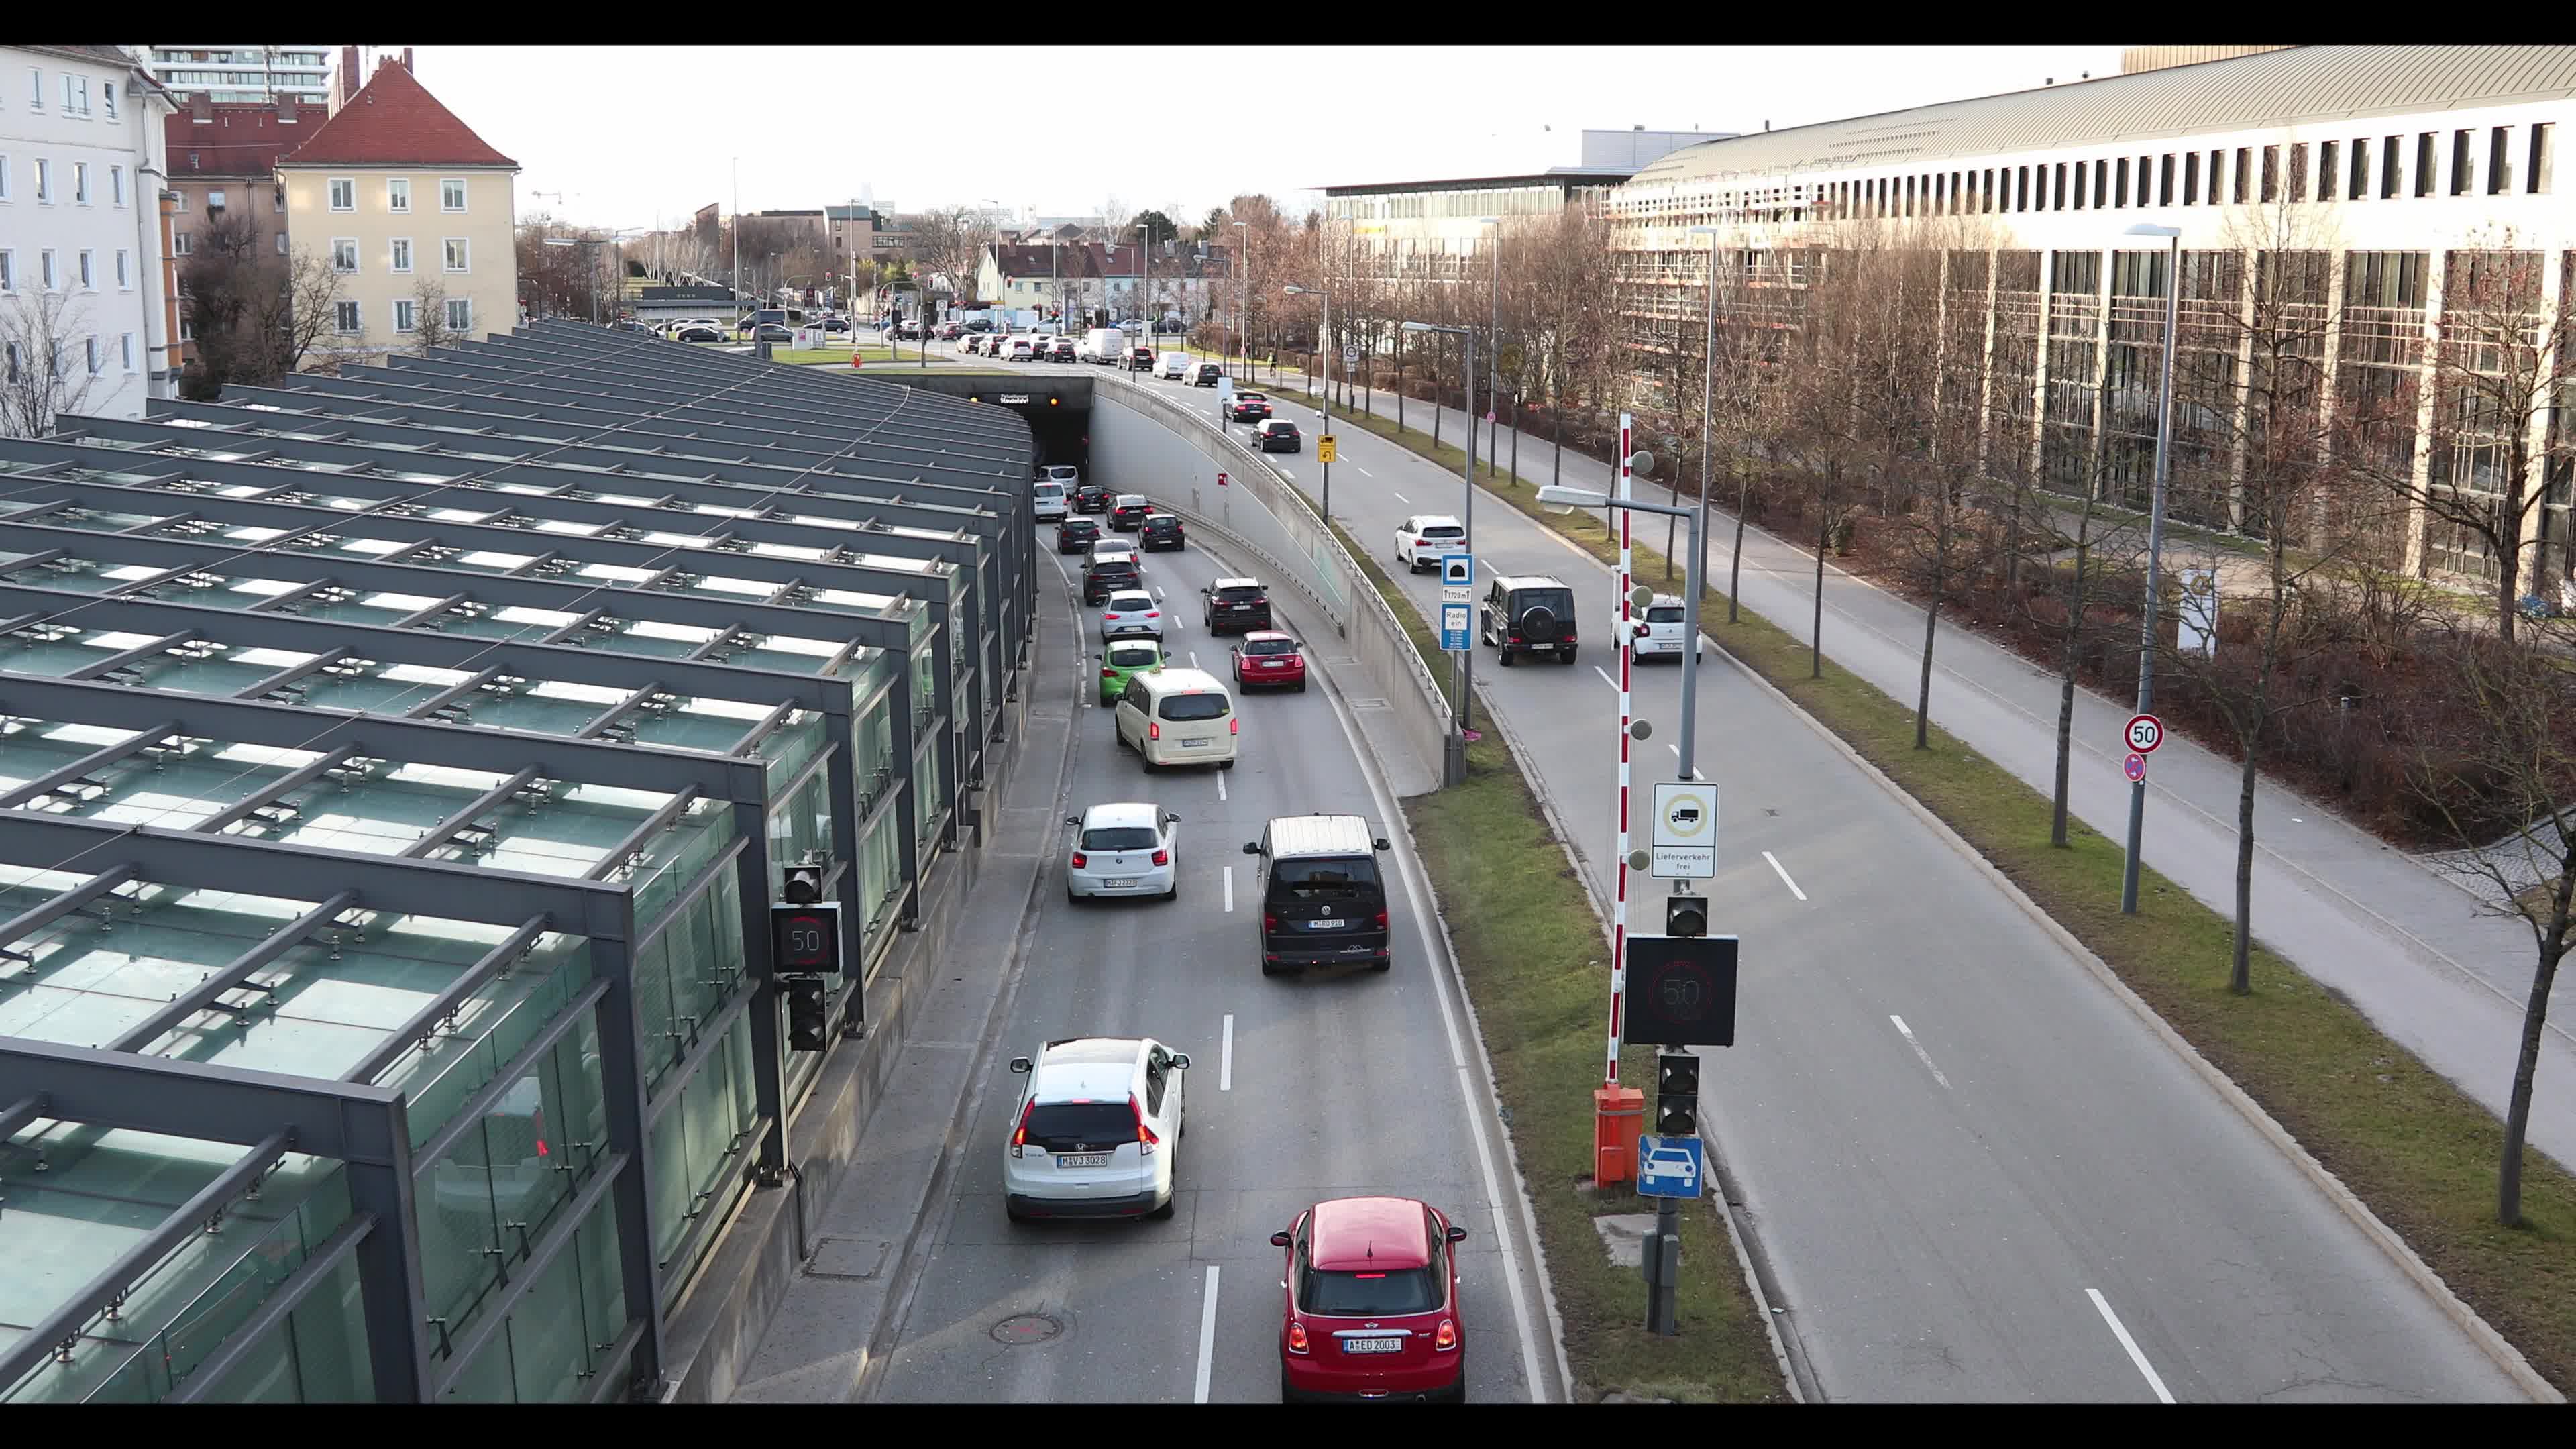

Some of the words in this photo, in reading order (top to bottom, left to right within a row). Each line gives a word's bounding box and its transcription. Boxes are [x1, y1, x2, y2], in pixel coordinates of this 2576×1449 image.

[2133, 726, 2155, 743] 50
[792, 930, 819, 951] 50
[1664, 979, 1700, 1005] 50
[1374, 1340, 1395, 1349] 2003
